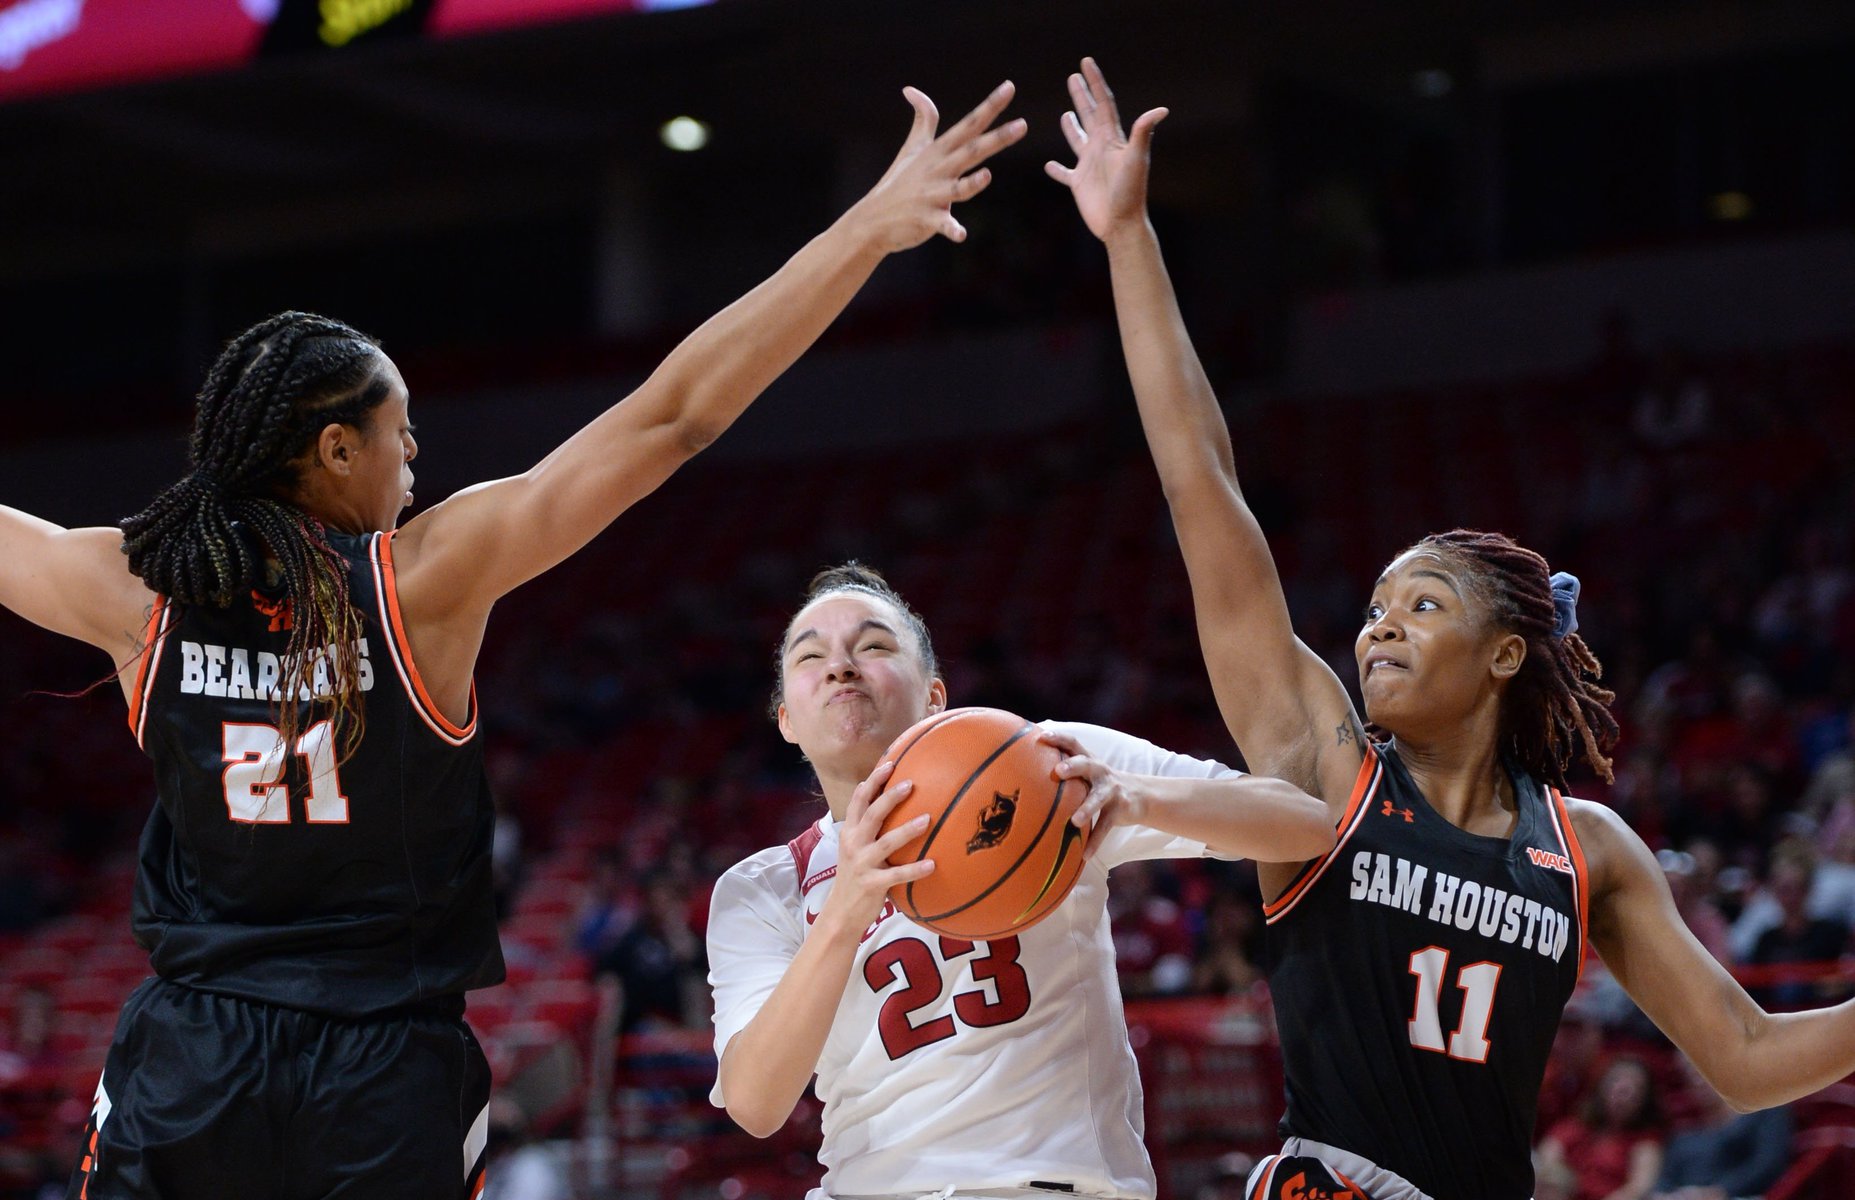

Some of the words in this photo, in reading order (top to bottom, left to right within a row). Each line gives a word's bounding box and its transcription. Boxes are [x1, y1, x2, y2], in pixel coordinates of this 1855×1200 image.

[222, 720, 350, 824] 21
[1350, 851, 1429, 916] SAM
[1428, 872, 1570, 964] HOUSTON
[1526, 846, 1573, 875] WAC
[863, 935, 1032, 1062] 23
[1408, 945, 1503, 1064] 11
